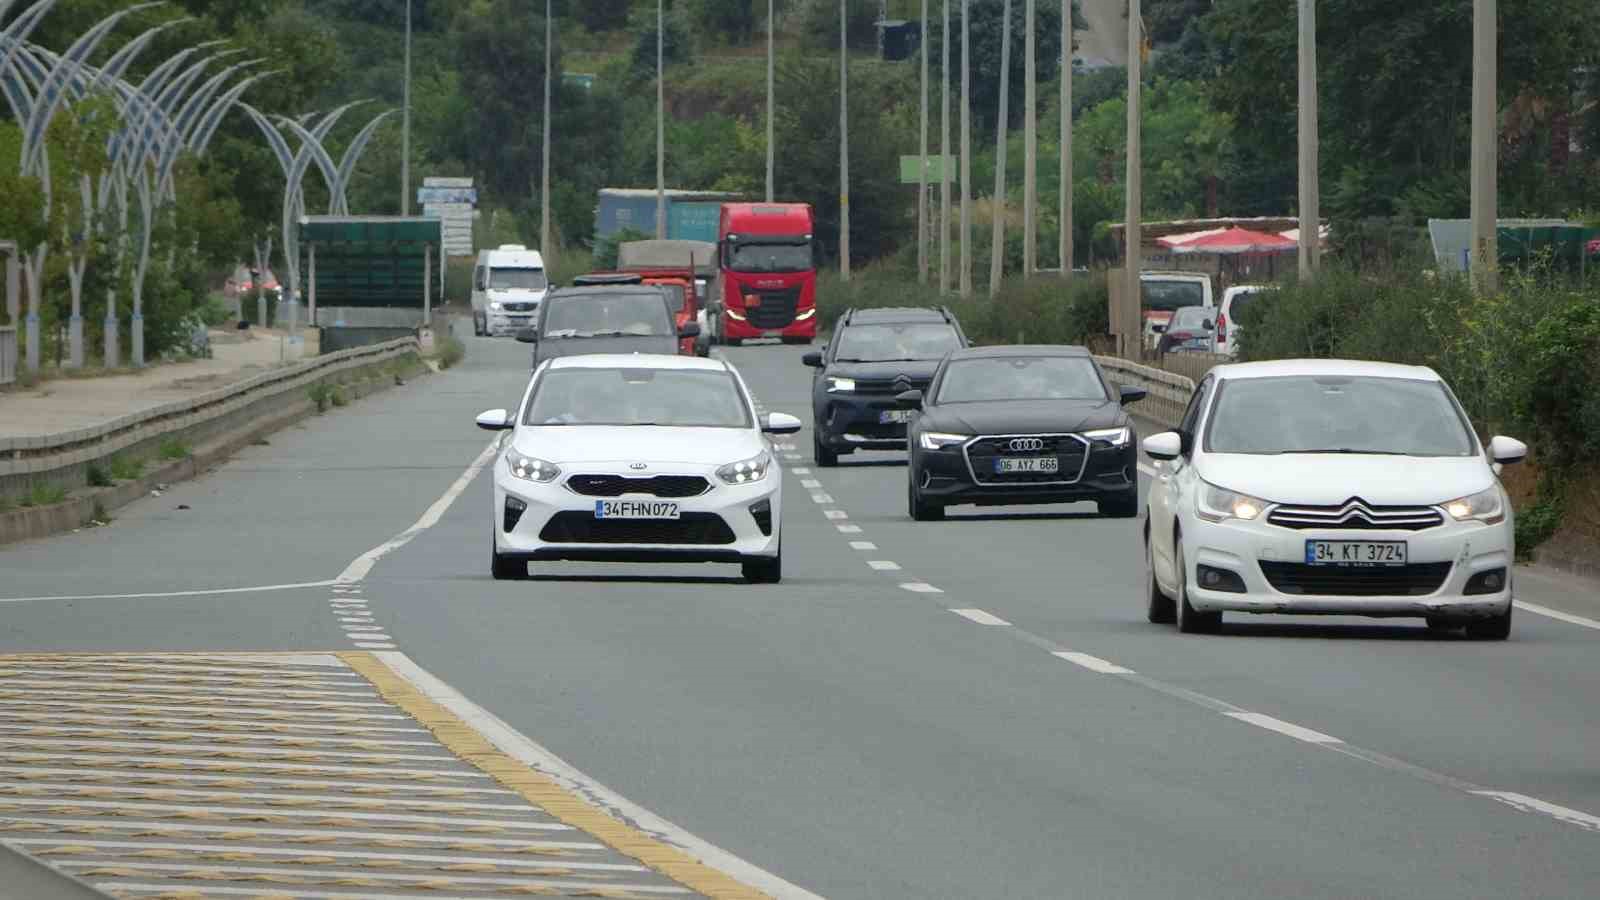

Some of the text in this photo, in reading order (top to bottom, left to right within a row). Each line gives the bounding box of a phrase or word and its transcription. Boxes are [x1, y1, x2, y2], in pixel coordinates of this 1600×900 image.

[1001, 460, 1012, 470] 06
[1017, 460, 1034, 470] AYZ
[603, 502, 678, 517] 34FHN072
[1317, 544, 1403, 560] 34 KT 3724
